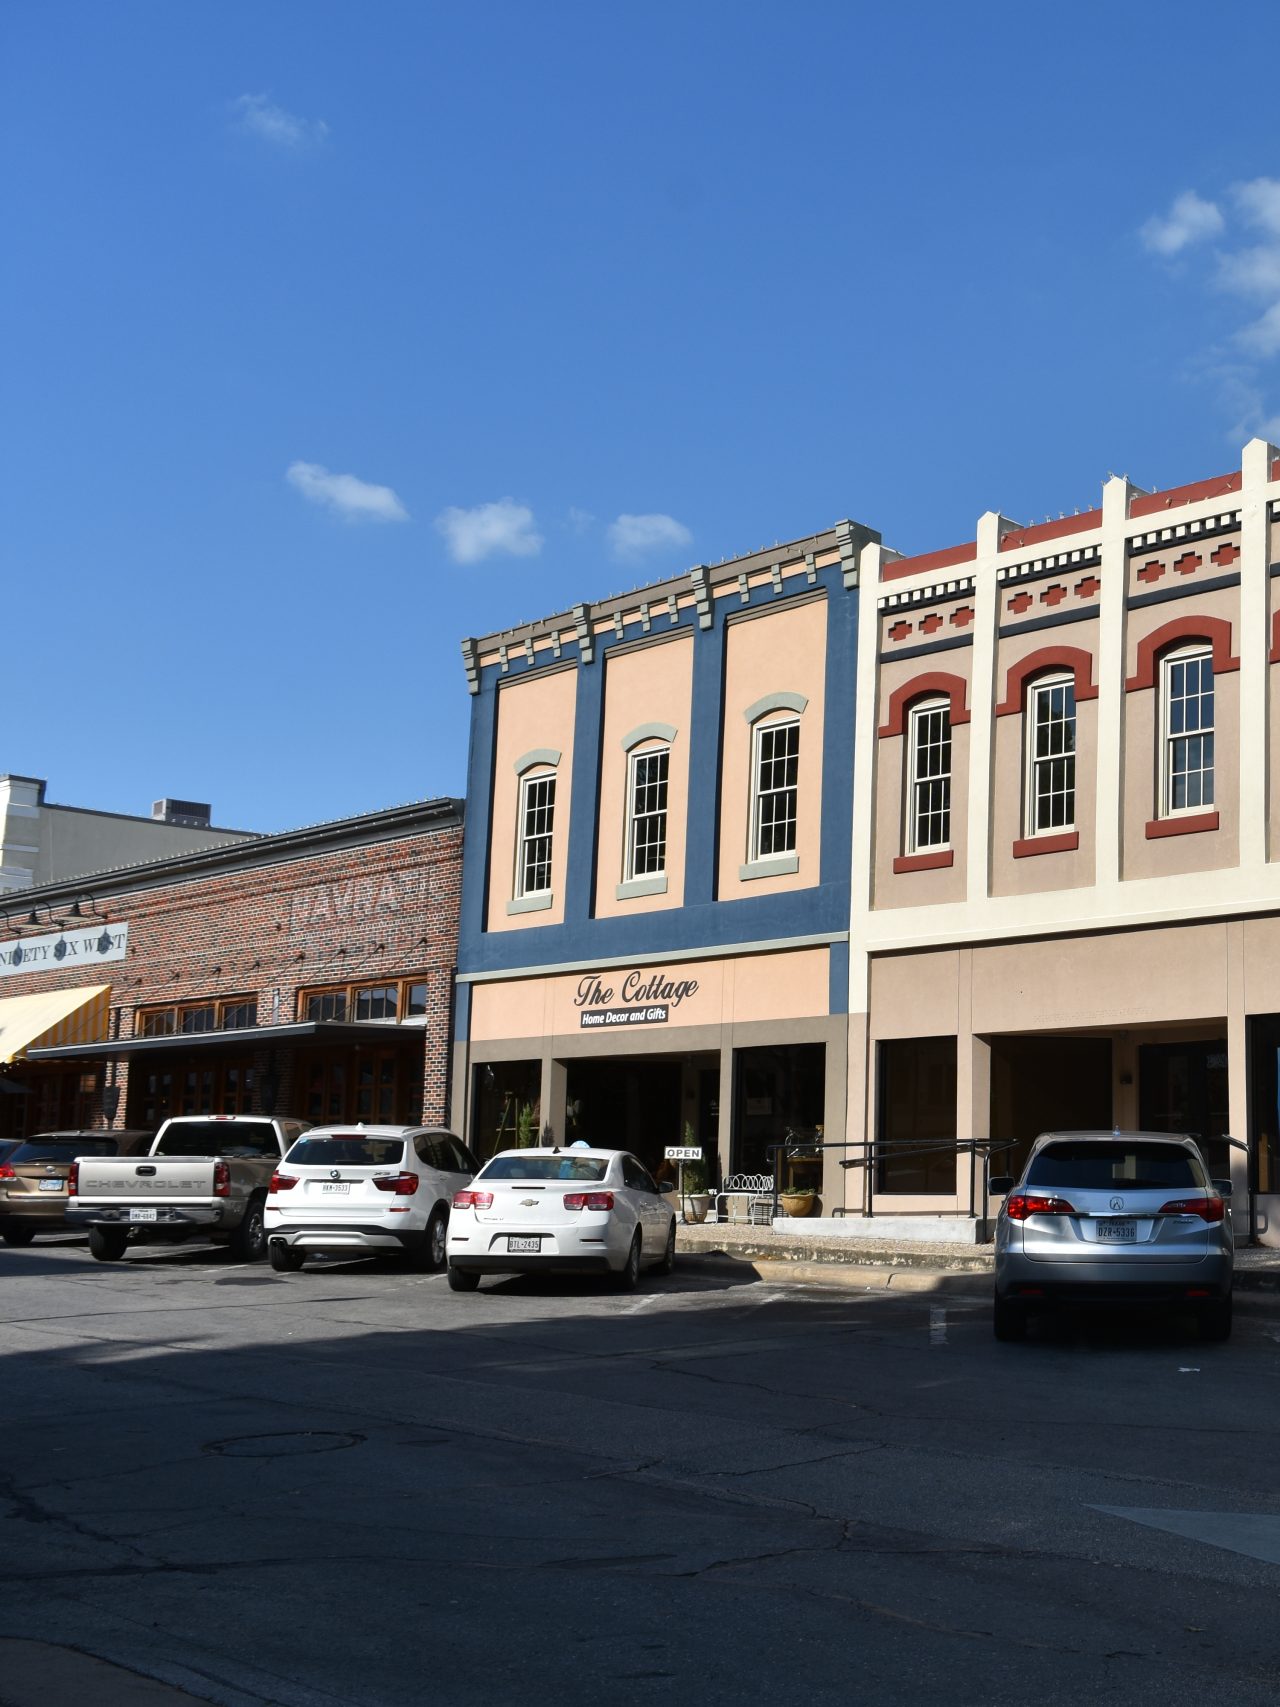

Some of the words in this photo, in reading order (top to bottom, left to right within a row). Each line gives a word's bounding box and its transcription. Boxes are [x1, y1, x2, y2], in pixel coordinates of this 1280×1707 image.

[574, 975, 615, 1006] The
[622, 971, 699, 1007] Cottage
[582, 1014, 604, 1025] Home
[606, 1011, 628, 1023] Decor
[630, 1009, 646, 1021] and
[647, 1007, 666, 1020] Gifts
[667, 1149, 700, 1158] OPEN
[85, 1180, 206, 1188] CHEVROLET
